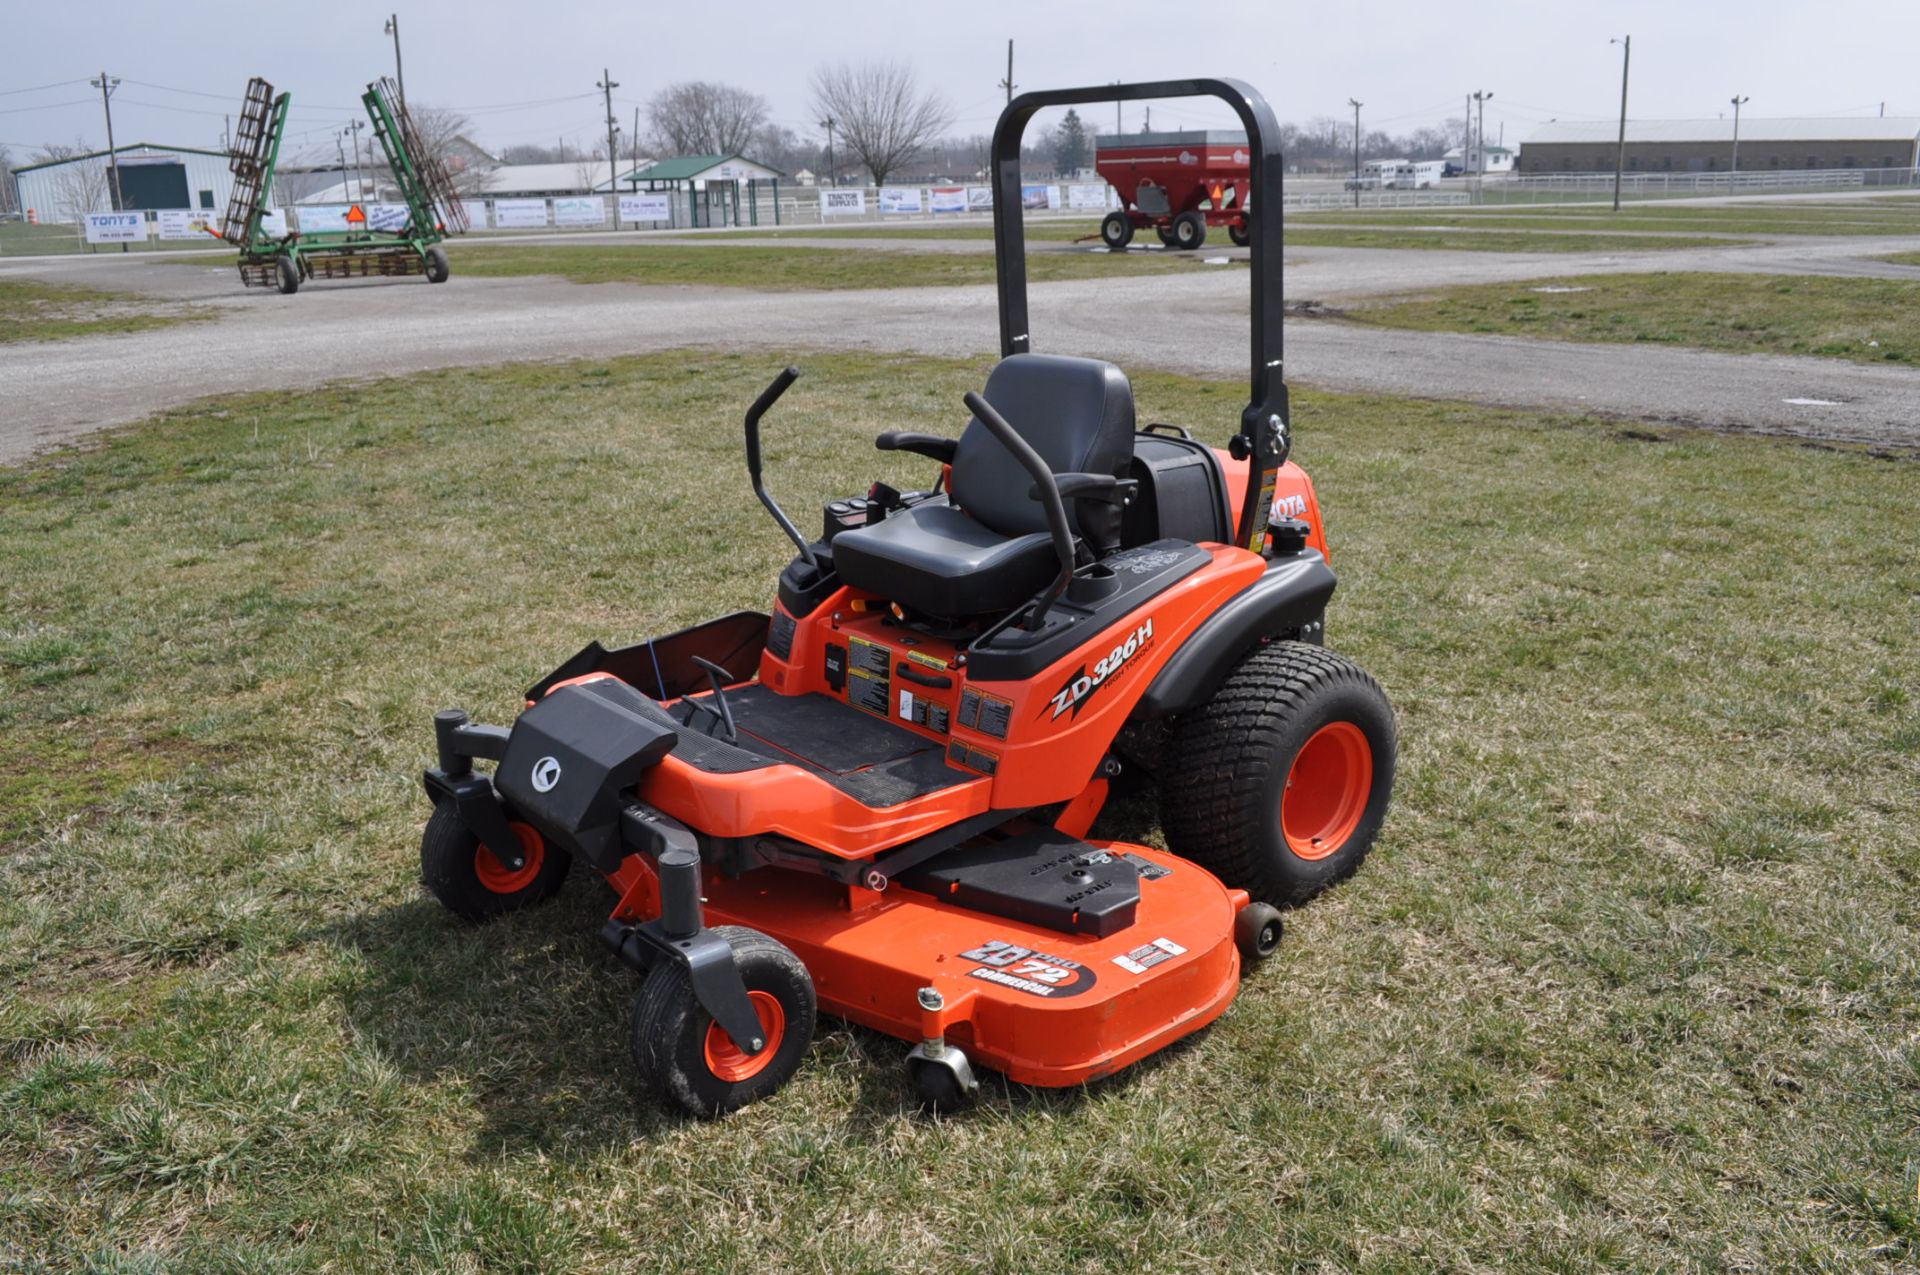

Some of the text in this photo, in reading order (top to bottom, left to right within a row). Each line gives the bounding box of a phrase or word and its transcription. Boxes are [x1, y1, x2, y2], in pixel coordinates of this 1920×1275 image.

[91, 215, 138, 226] TONY'S
[960, 940, 1081, 969] ZD PRO
[972, 968, 1055, 996] COMMERCIAL
[1014, 960, 1070, 984] 72
